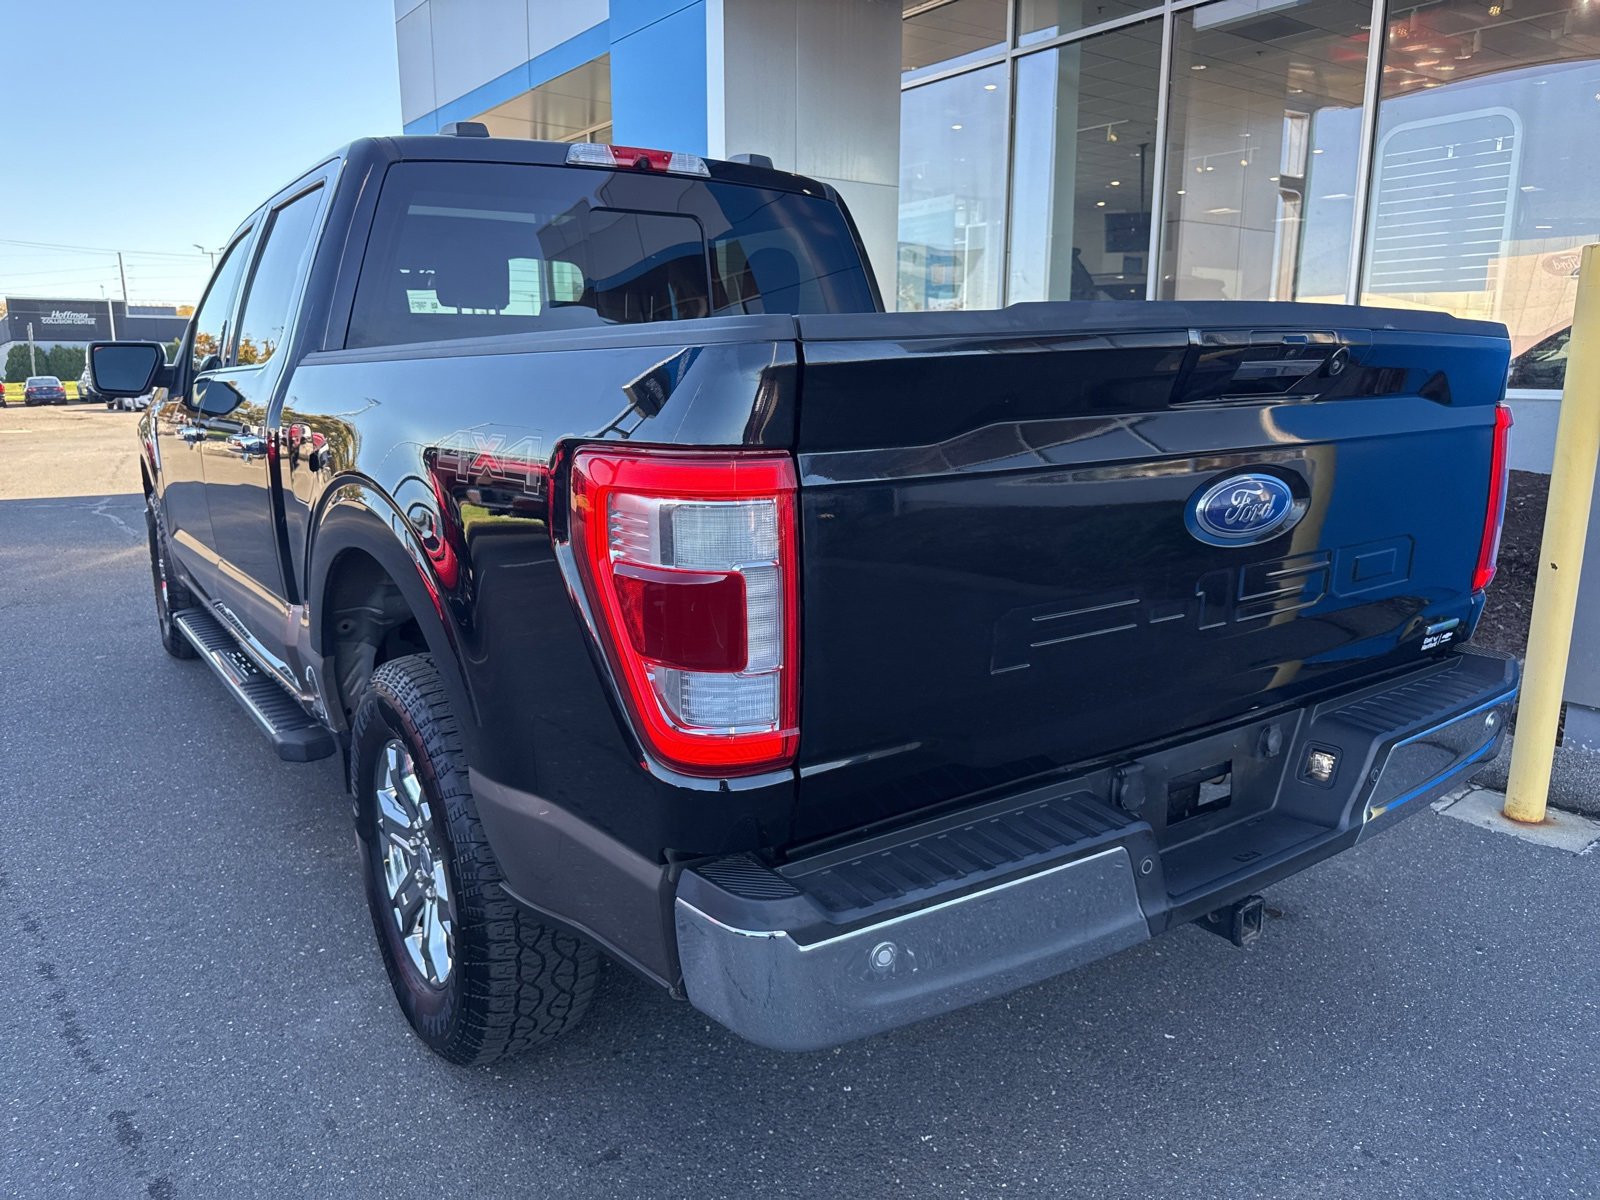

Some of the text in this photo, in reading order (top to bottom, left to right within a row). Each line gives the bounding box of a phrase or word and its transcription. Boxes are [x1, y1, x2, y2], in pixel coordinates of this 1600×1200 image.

[51, 310, 89, 319] Hoffman
[1225, 488, 1276, 525] Ford
[989, 534, 1416, 674] F-150
